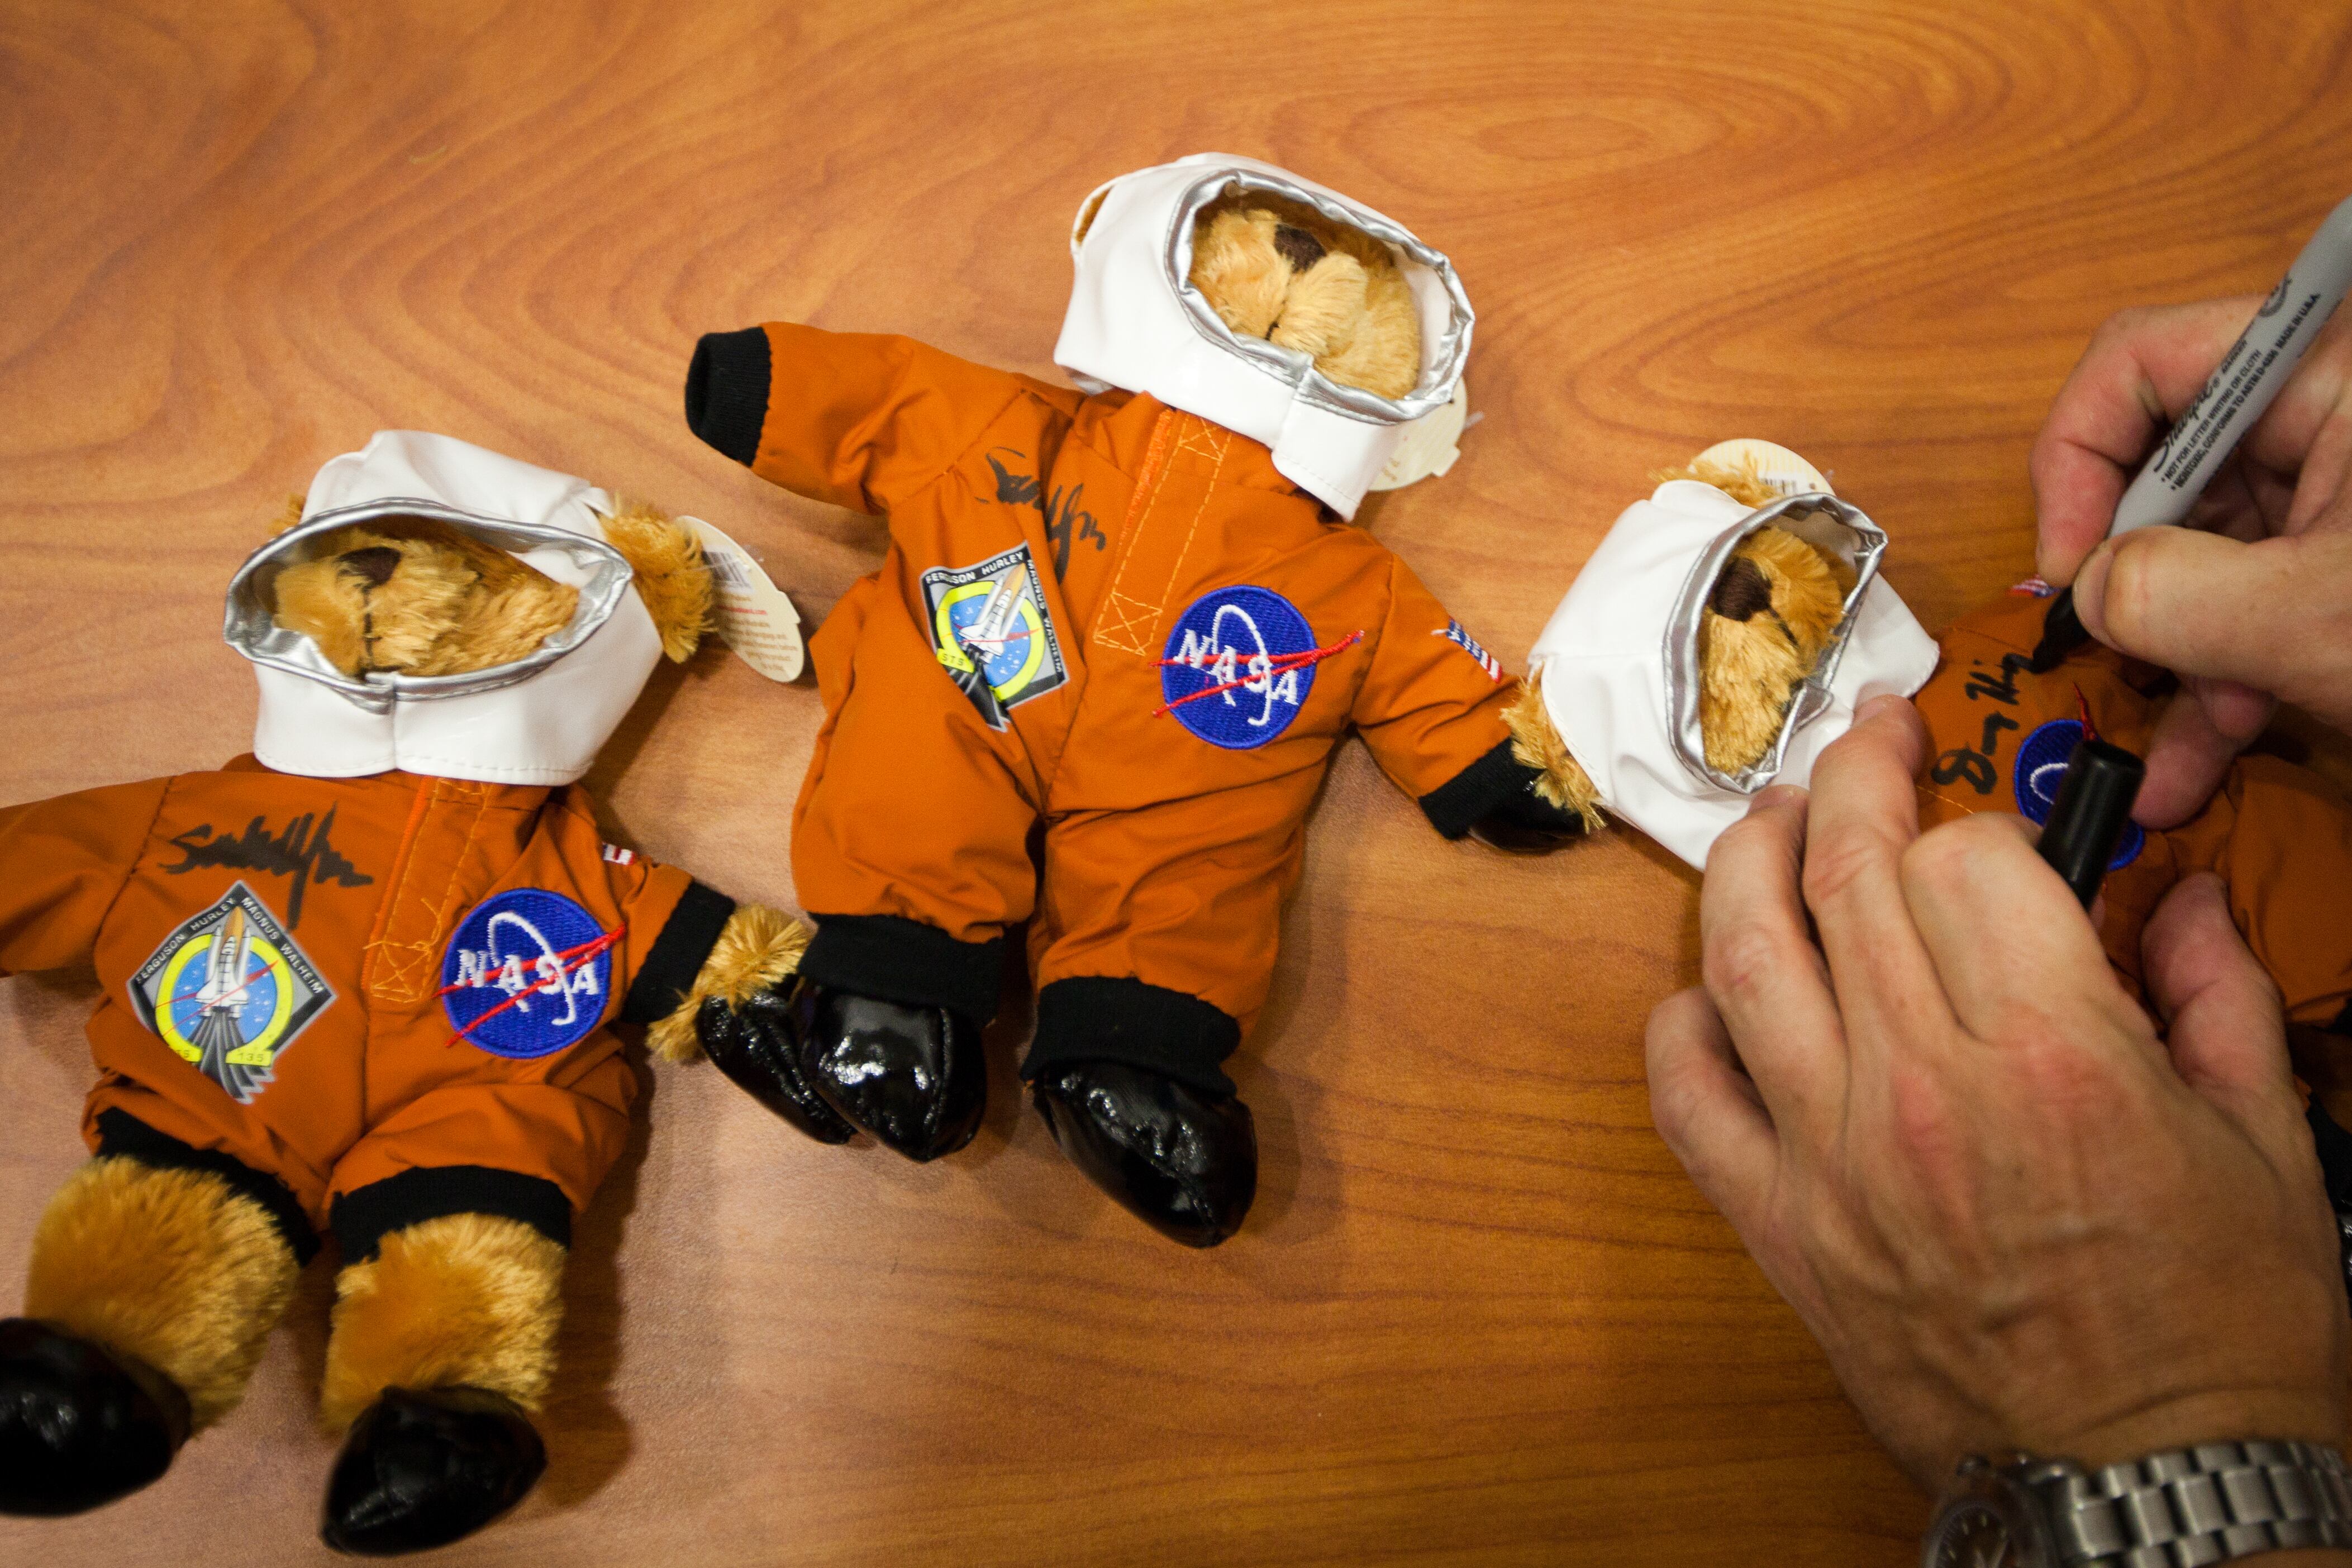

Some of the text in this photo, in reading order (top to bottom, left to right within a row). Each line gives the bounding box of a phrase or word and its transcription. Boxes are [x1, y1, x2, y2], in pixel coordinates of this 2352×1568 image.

[2163, 349, 2263, 479] NOT FOR LETTER WRITING OR CLOTH
[2231, 393, 2246, 408] TO
[925, 551, 1023, 584] FERSON HURLEY
[942, 653, 964, 666] STS
[1174, 628, 1299, 706] NASA
[135, 897, 236, 983] FERGUSON HURLEY
[240, 897, 325, 995] MAGNUS WALHEIM
[454, 949, 599, 995] NASA
[237, 1052, 264, 1062] 135
